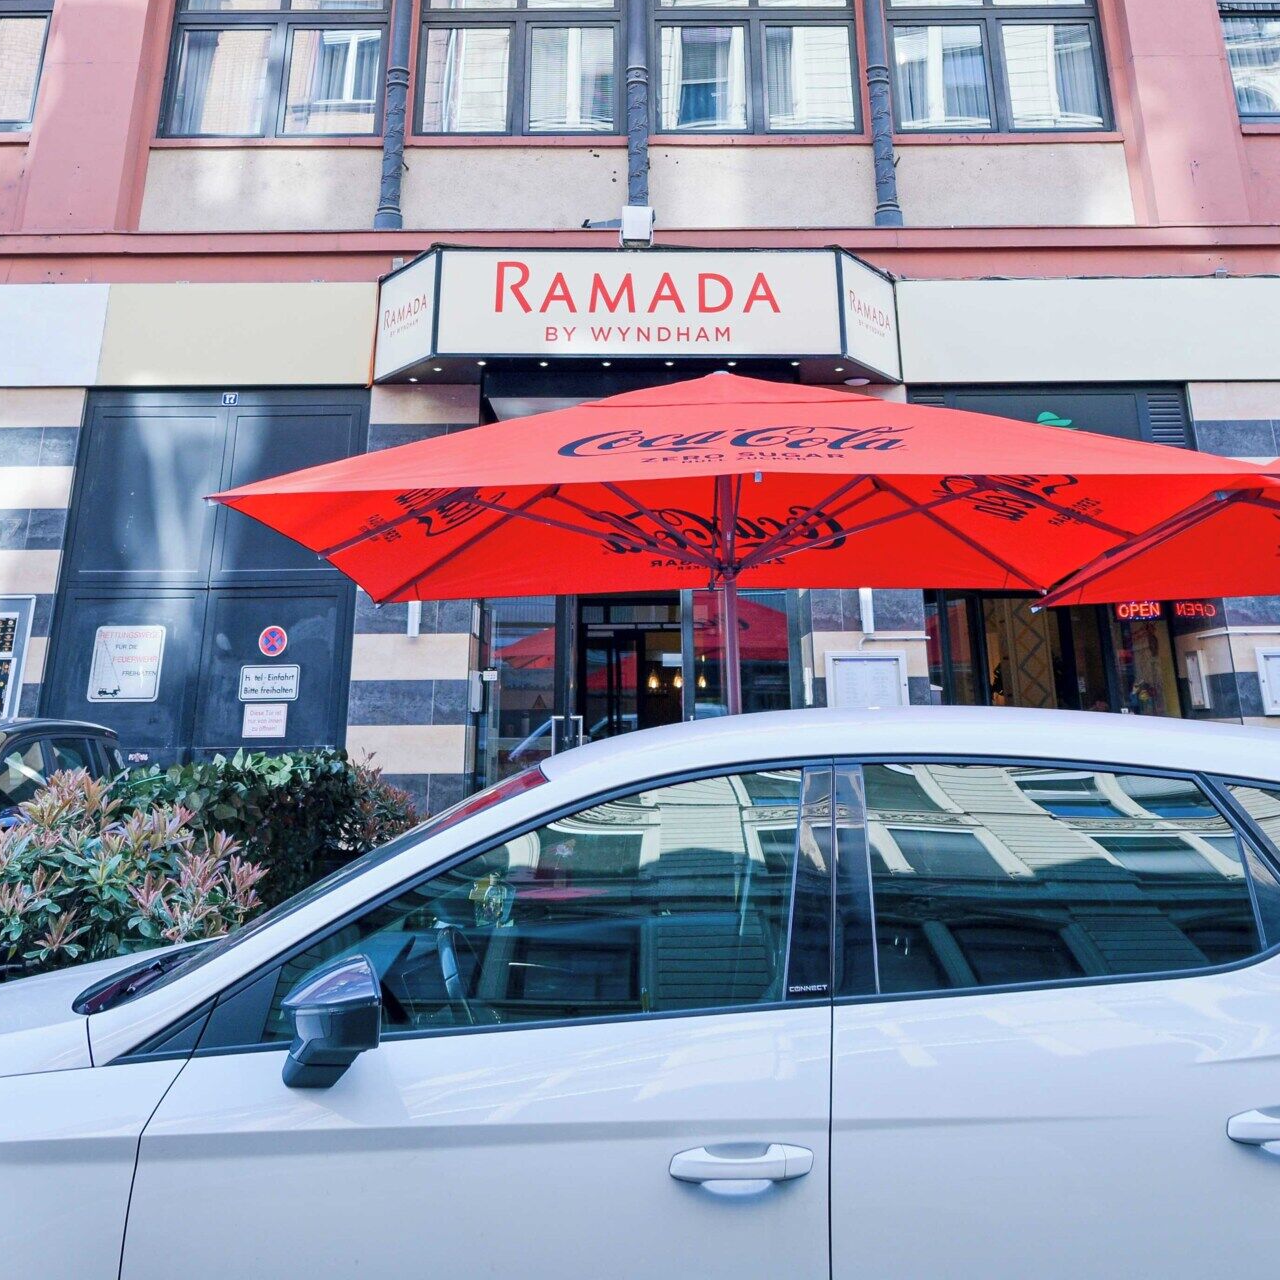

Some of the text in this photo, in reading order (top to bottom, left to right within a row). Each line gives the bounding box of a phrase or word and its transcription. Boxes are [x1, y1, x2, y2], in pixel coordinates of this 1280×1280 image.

[494, 261, 782, 313] RAMADA
[383, 293, 427, 331] RAMADA
[849, 289, 891, 331] RAMADA
[545, 326, 731, 342] BY WYNDHAM
[224, 393, 236, 404] 17
[557, 425, 914, 458] Coca-Cola
[641, 451, 845, 464] ZERO SUGAR
[1118, 602, 1161, 618] OPEN
[260, 685, 294, 694] freihalten
